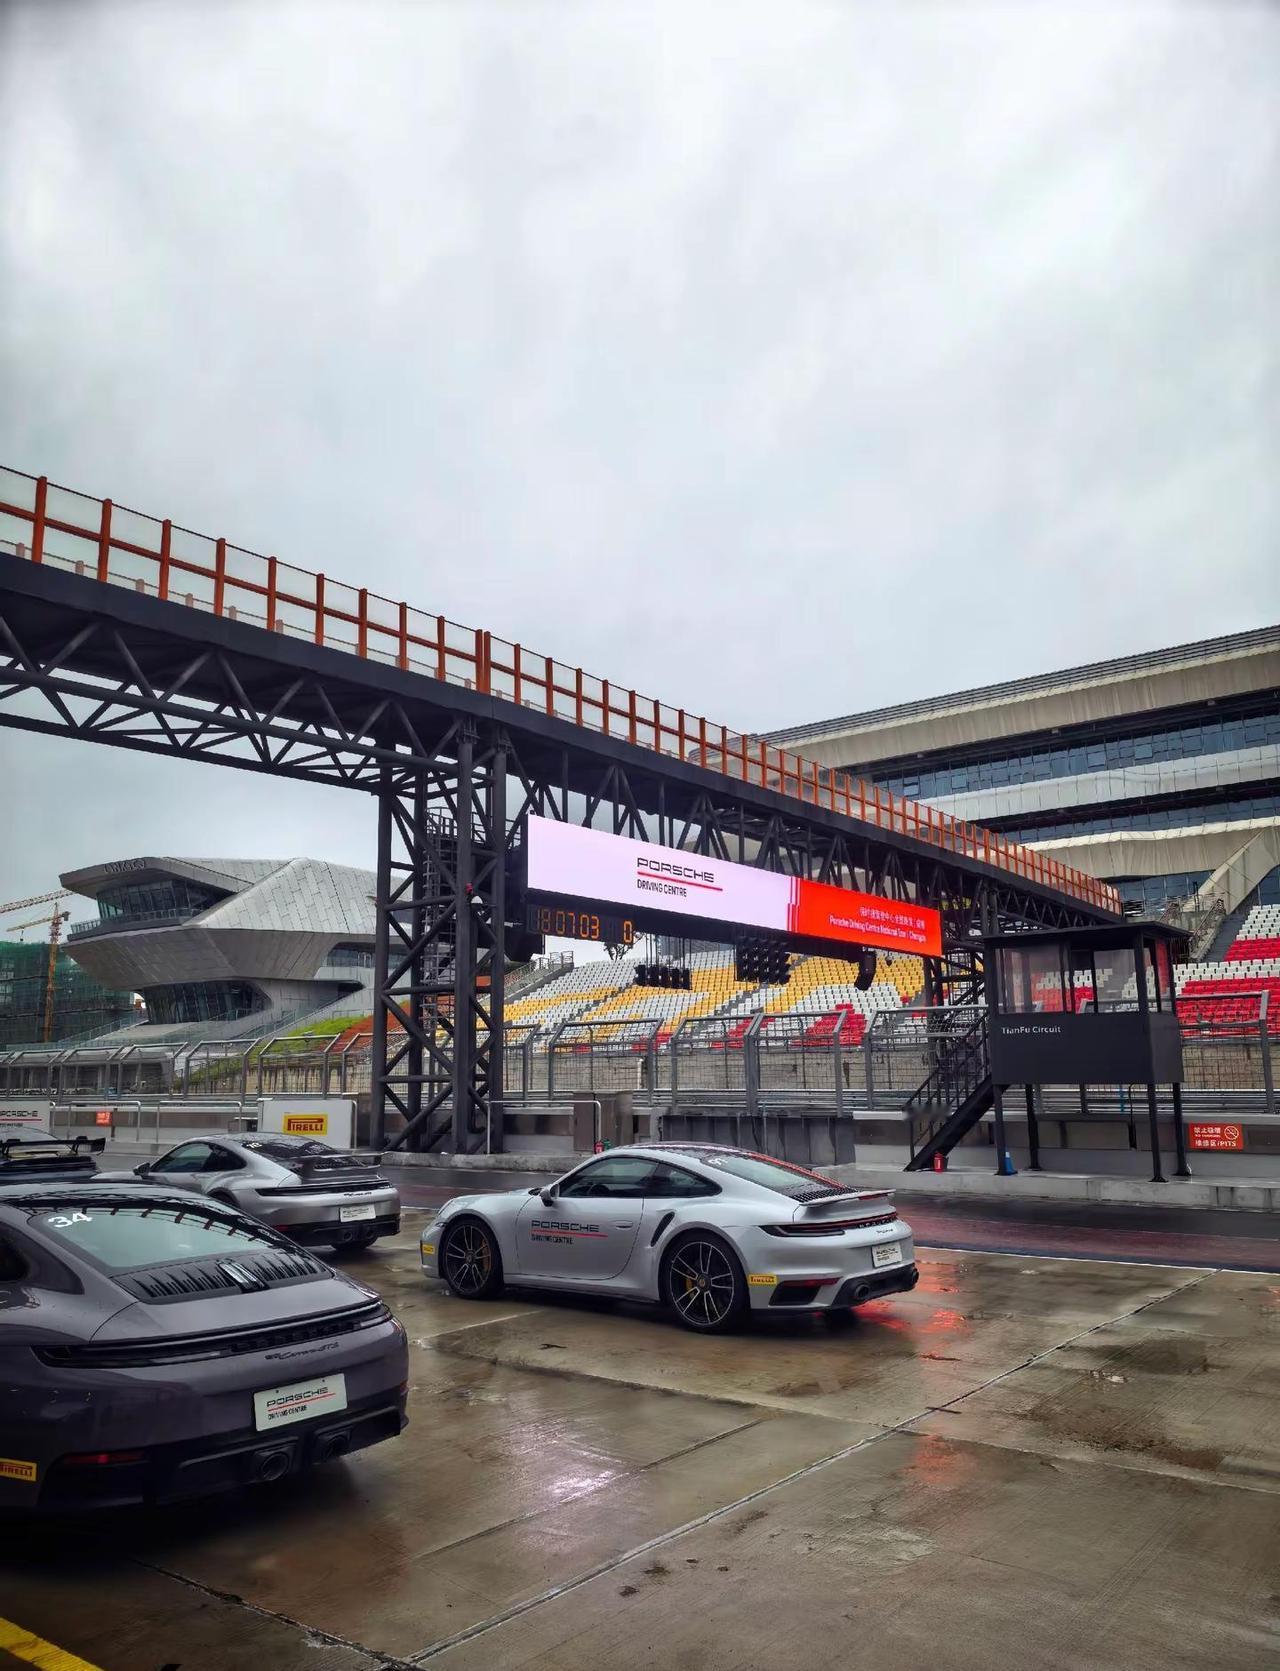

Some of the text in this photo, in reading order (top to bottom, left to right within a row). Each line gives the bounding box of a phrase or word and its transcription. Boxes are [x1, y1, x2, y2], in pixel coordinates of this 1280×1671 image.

[637, 857, 714, 883] PORSCHE
[637, 879, 687, 898] DRIVING CENTRE
[287, 1118, 324, 1131] PIRELLI
[48, 1212, 93, 1228] 34
[531, 1220, 600, 1233] PORSCHE
[266, 1387, 328, 1407] PORSCHE
